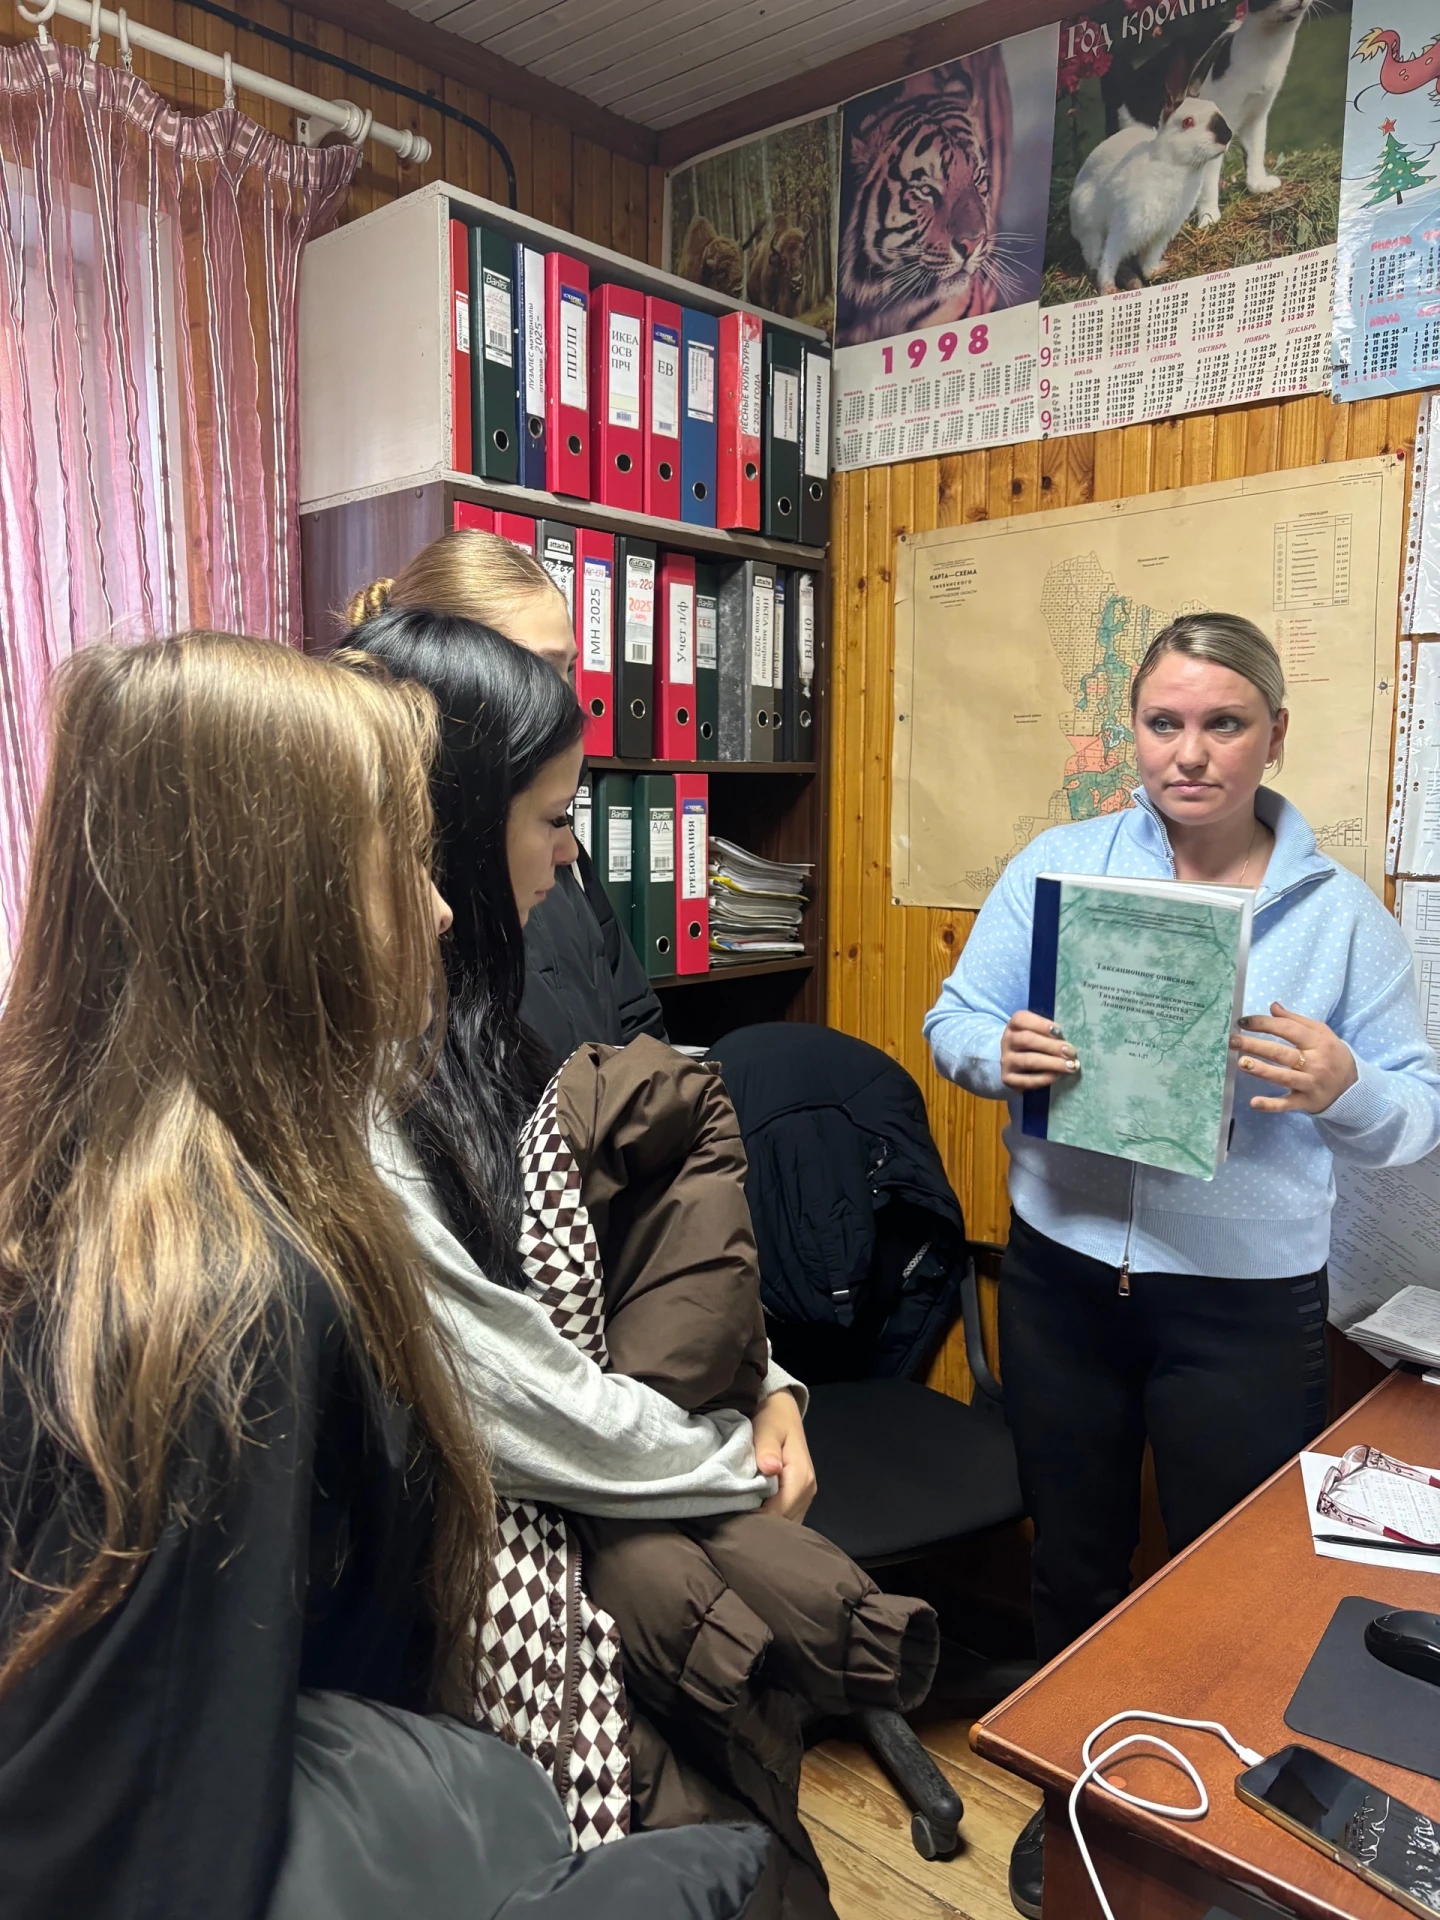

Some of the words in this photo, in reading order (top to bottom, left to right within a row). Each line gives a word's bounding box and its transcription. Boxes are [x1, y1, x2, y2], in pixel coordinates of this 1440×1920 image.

[1064, 21, 1113, 60] Год
[486, 274, 508, 291] Bantex
[612, 330, 639, 345] ИКЕА
[567, 326, 577, 380] ППЛП
[612, 345, 632, 357] ОСВ
[882, 324, 989, 374] 1998
[611, 359, 630, 371] ПРЧ
[657, 360, 674, 376] ЕВ
[591, 589, 600, 624] 2025
[628, 597, 653, 612] 2025
[678, 628, 686, 663] Учет
[610, 810, 629, 819] Bantex
[652, 812, 670, 820] Bantex
[1096, 962, 1154, 979] Таксационное
[1156, 974, 1196, 986] описание
